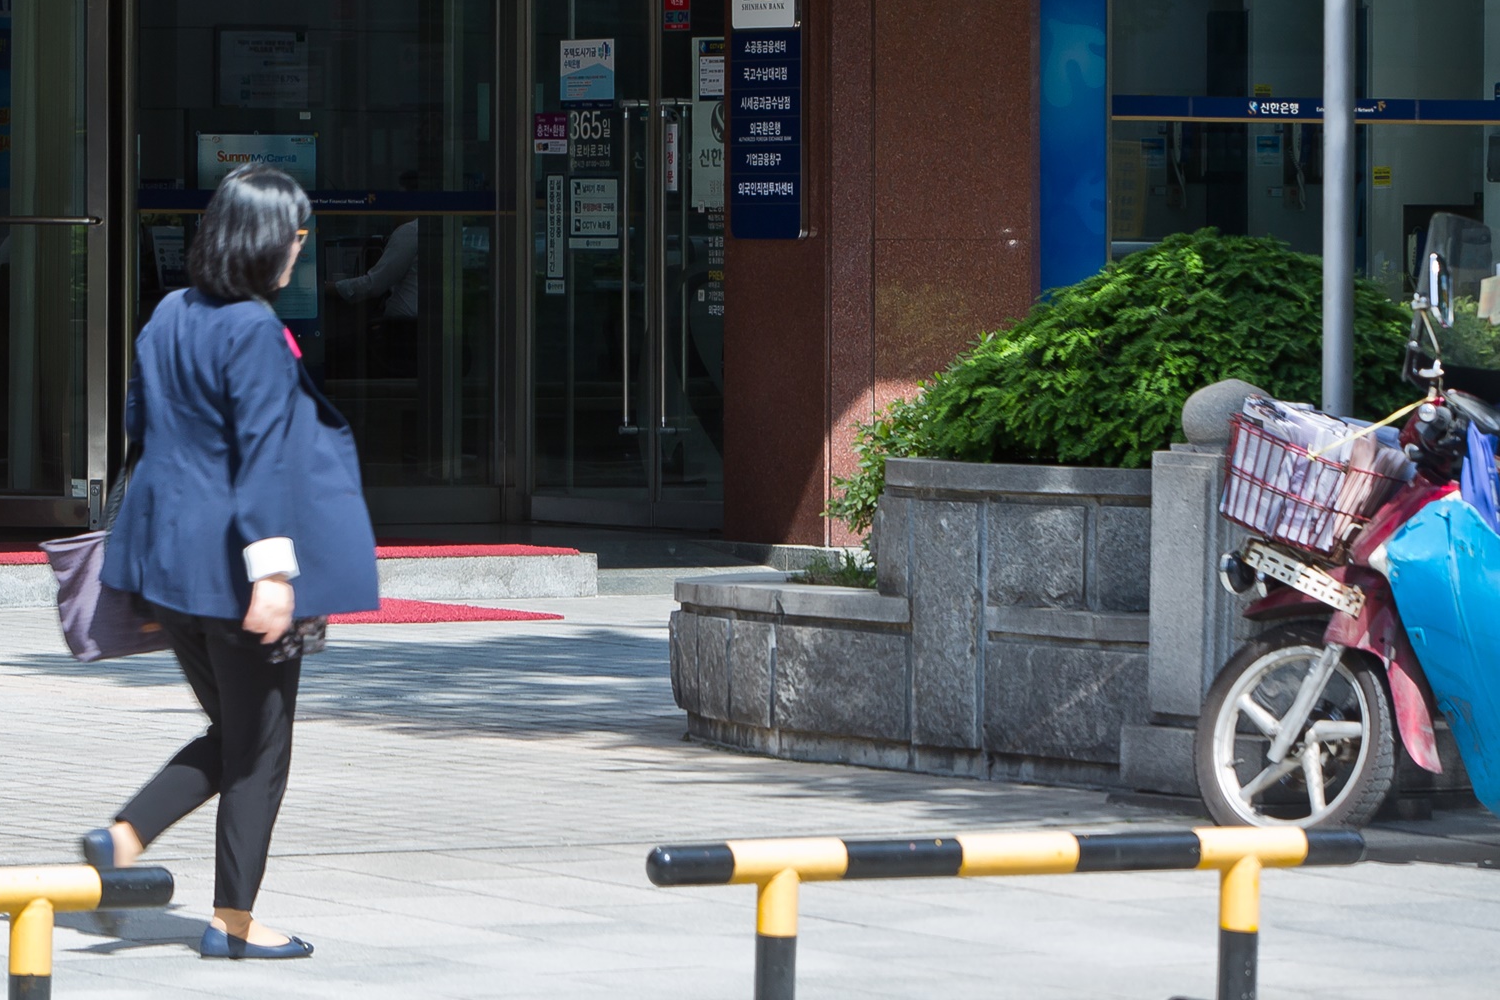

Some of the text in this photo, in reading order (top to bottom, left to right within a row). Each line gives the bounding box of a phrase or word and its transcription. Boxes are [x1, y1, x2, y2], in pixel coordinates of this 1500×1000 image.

[741, 2, 785, 11] SHINHAN BANK
[563, 47, 597, 58] 주택도시기금
[744, 39, 787, 54] 소공동금융센터
[743, 67, 788, 81] 국고수납대리점
[1260, 102, 1299, 115] 신한은행
[569, 110, 611, 140] 365일
[749, 121, 782, 136] 외국환은행
[746, 153, 782, 167] 기업금융창구
[738, 182, 793, 196] 외국인직접투자센터
[582, 221, 596, 229] CCTV
